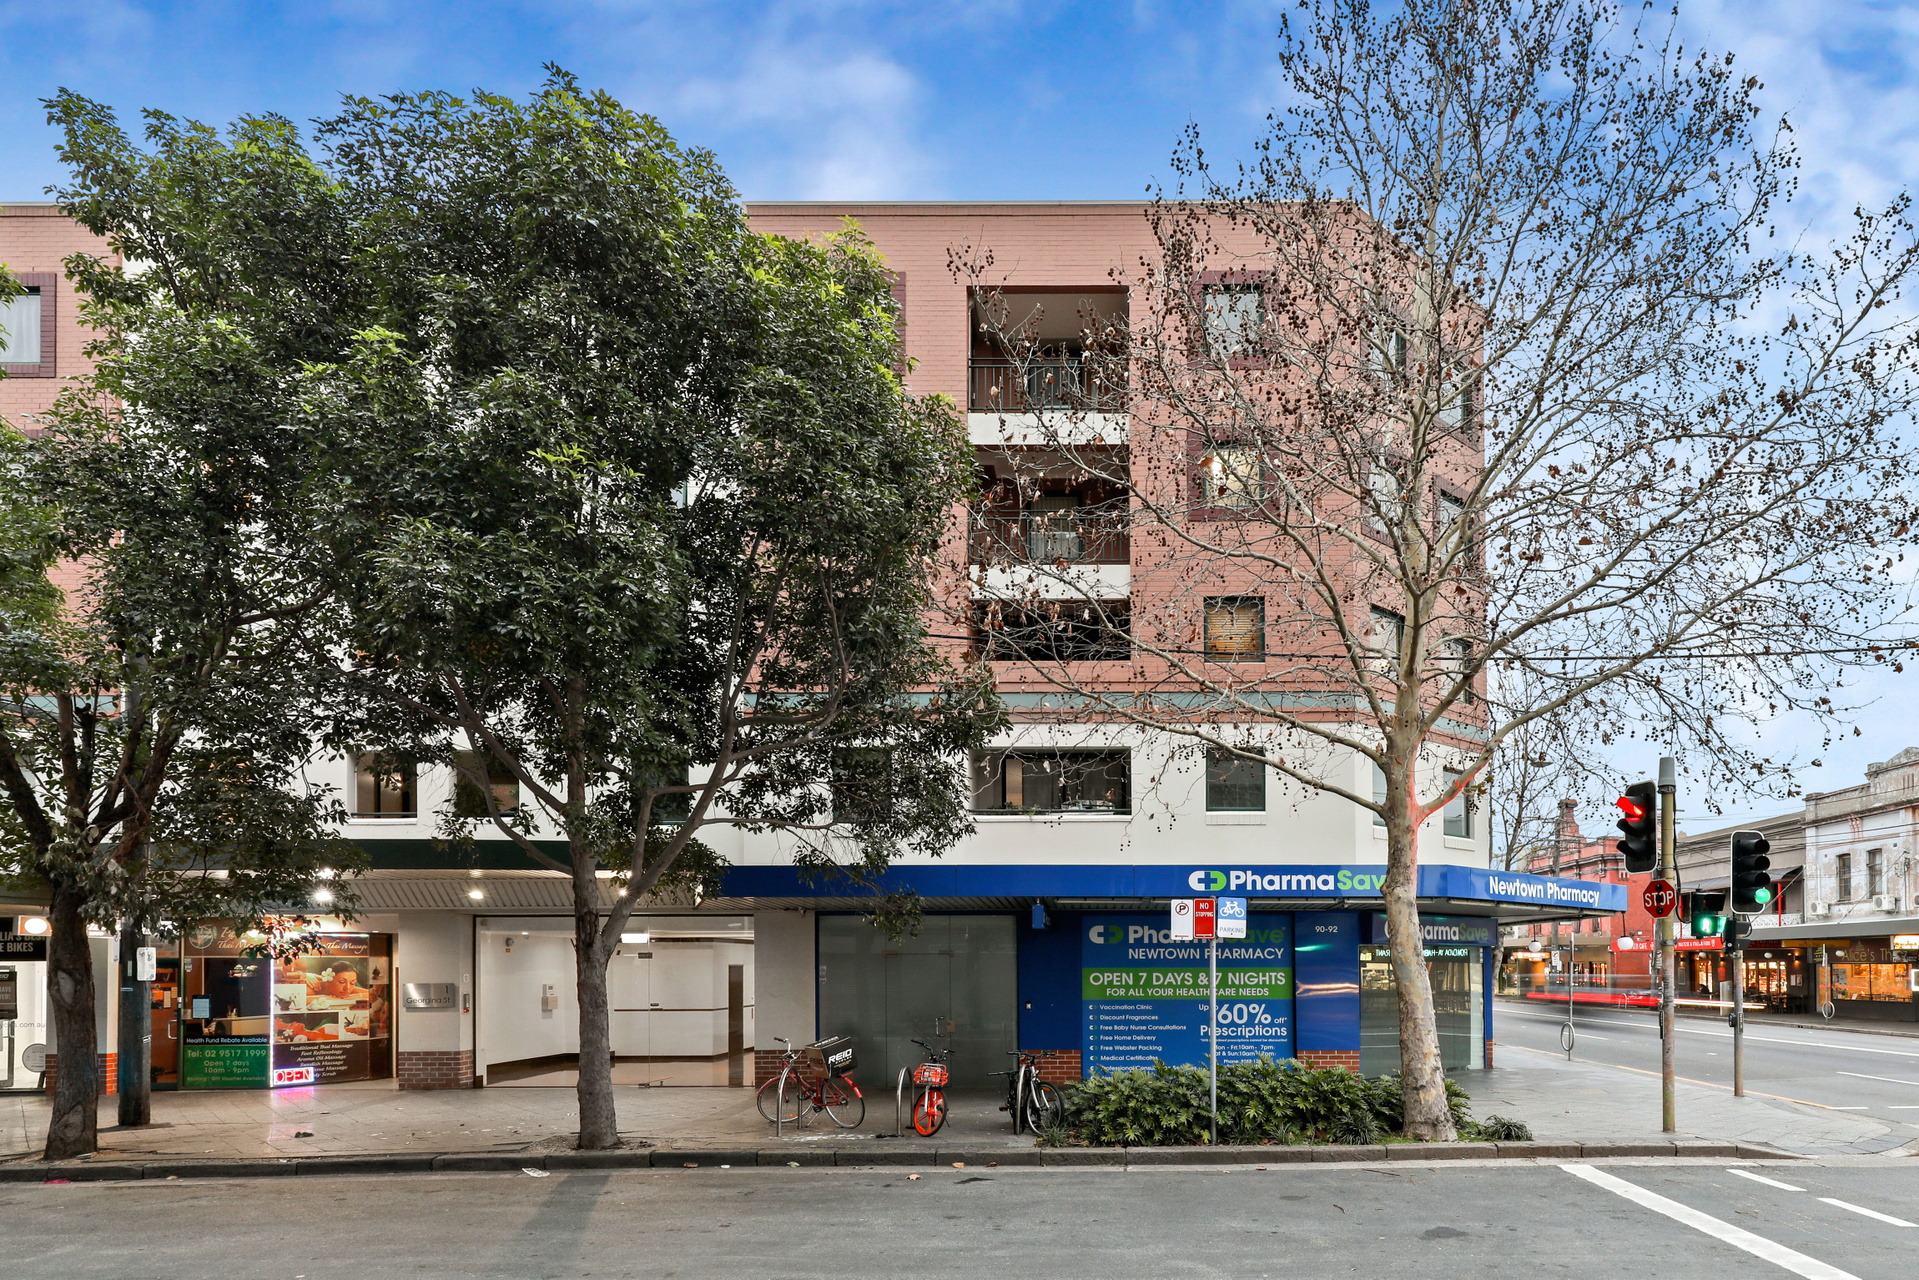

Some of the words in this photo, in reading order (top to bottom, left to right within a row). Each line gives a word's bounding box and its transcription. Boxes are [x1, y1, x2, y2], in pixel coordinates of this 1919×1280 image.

[1229, 870, 1386, 891] PharmaSav
[1489, 876, 1544, 898] Newtown
[1546, 882, 1600, 906] Pharmacy
[1644, 890, 1674, 907] STOP
[1199, 902, 1209, 910] NO
[1219, 926, 1244, 934] PARKING
[1315, 925, 1338, 933] 90-92
[7, 942, 34, 952] BIKES
[1128, 948, 1200, 959] NEWTOWN
[1204, 948, 1284, 959] PHARMACY
[1841, 948, 1875, 962] Alice's
[1089, 972, 1133, 986] OPEN
[1138, 972, 1147, 985] 7
[1152, 972, 1193, 985] DAYS
[1199, 972, 1210, 986] &
[1228, 972, 1286, 985] NIGHTS
[445, 985, 449, 994] 1
[1106, 988, 1126, 996] FOR
[1127, 988, 1144, 996] ALL
[1146, 988, 1173, 996] YOUR
[1239, 988, 1269, 996] NEEDS
[405, 996, 442, 1005] Georgina
[443, 996, 450, 1004] St
[1198, 1003, 1210, 1011] Up
[1217, 1003, 1272, 1024] 60%
[187, 1050, 202, 1058] Tel:
[245, 1049, 267, 1057] 1999
[828, 1048, 853, 1065] REID
[276, 1069, 310, 1083] OPEN
